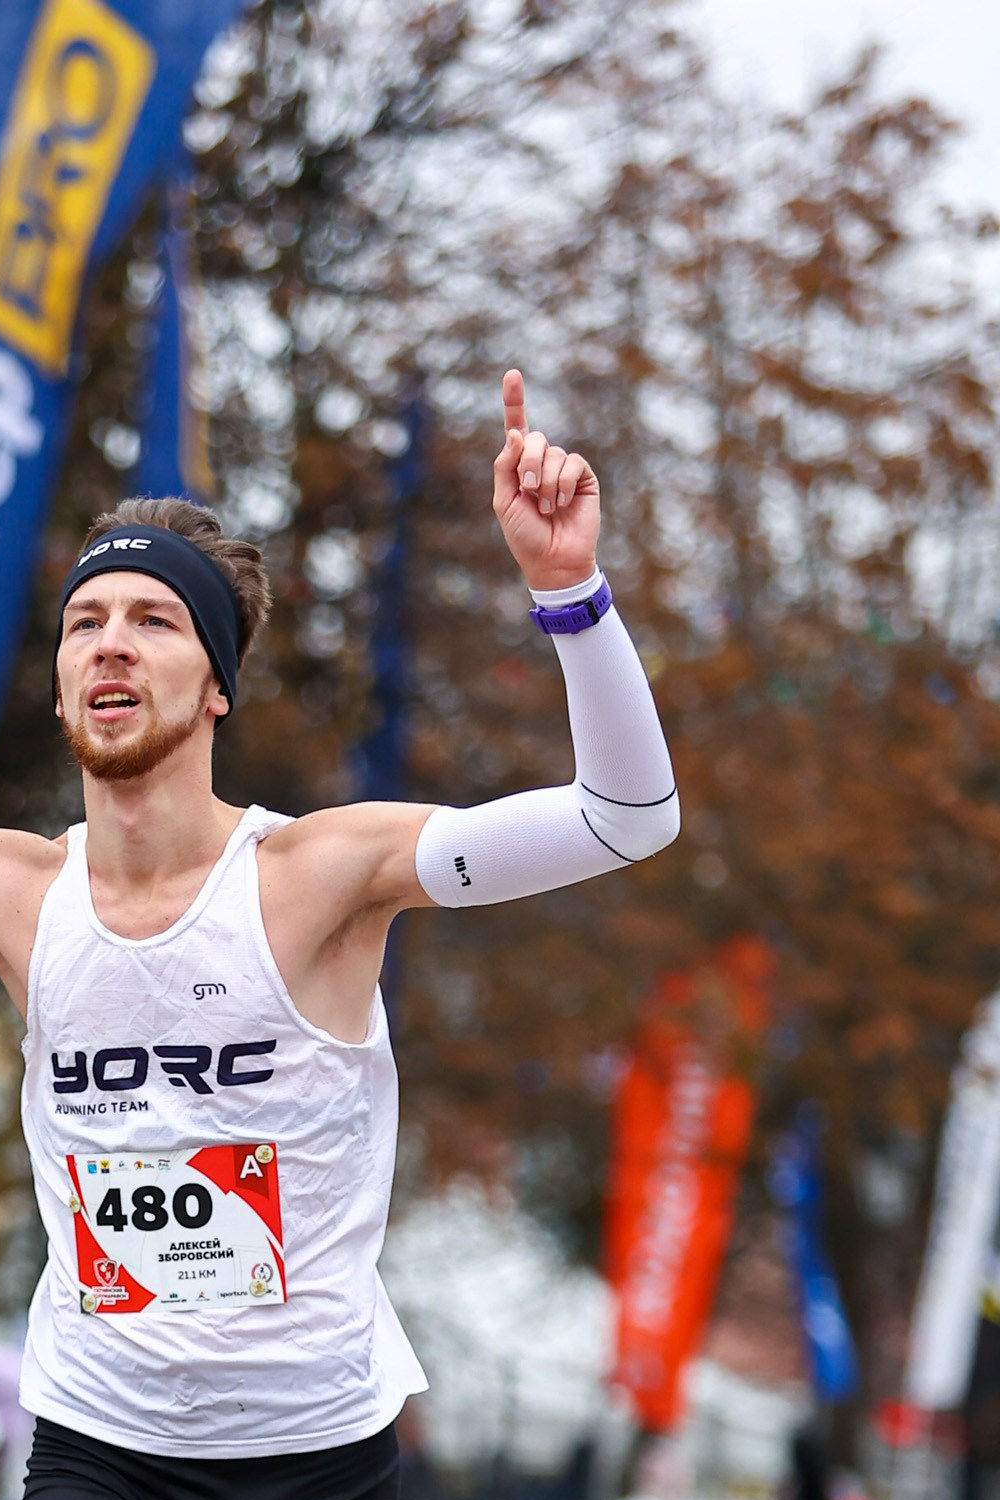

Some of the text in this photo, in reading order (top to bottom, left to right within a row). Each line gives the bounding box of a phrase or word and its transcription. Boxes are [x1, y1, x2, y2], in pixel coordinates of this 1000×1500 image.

[51, 1039, 277, 1094] YORC
[55, 1101, 149, 1115] RUNNING TEAM
[96, 1183, 213, 1232] 480
[169, 1238, 221, 1251] АЛЕКСЕЙ
[158, 1248, 234, 1262] ЗБОРОВСКИЙ
[178, 1271, 198, 1280] 21.1
